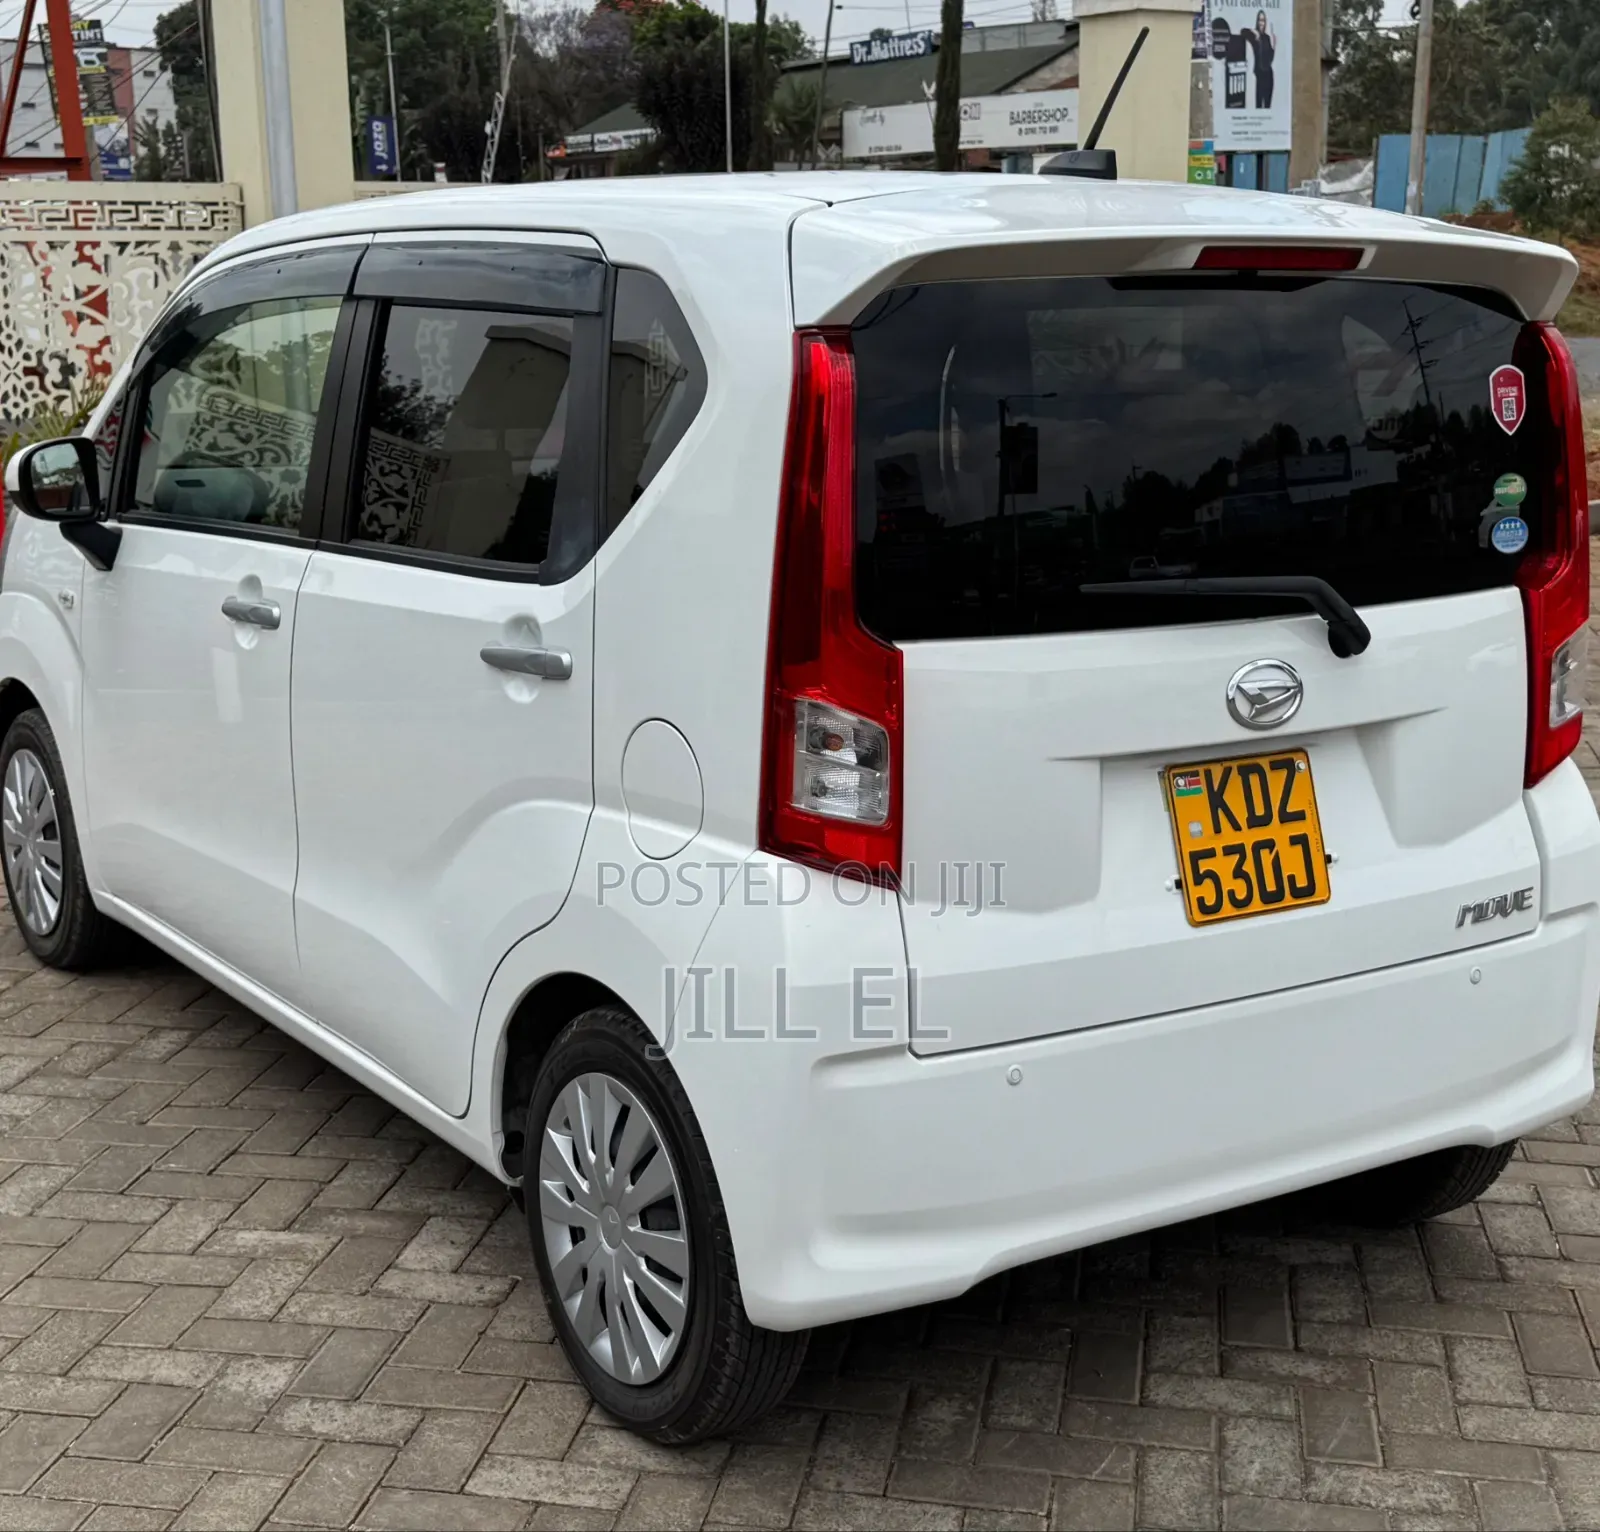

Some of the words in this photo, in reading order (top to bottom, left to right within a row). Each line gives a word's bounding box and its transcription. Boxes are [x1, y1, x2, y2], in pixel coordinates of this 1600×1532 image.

[1009, 107, 1069, 126] BARBERSHOP
[1203, 757, 1306, 834] KDZ
[1189, 832, 1316, 916] 530J
[1455, 886, 1534, 929] MOVE
